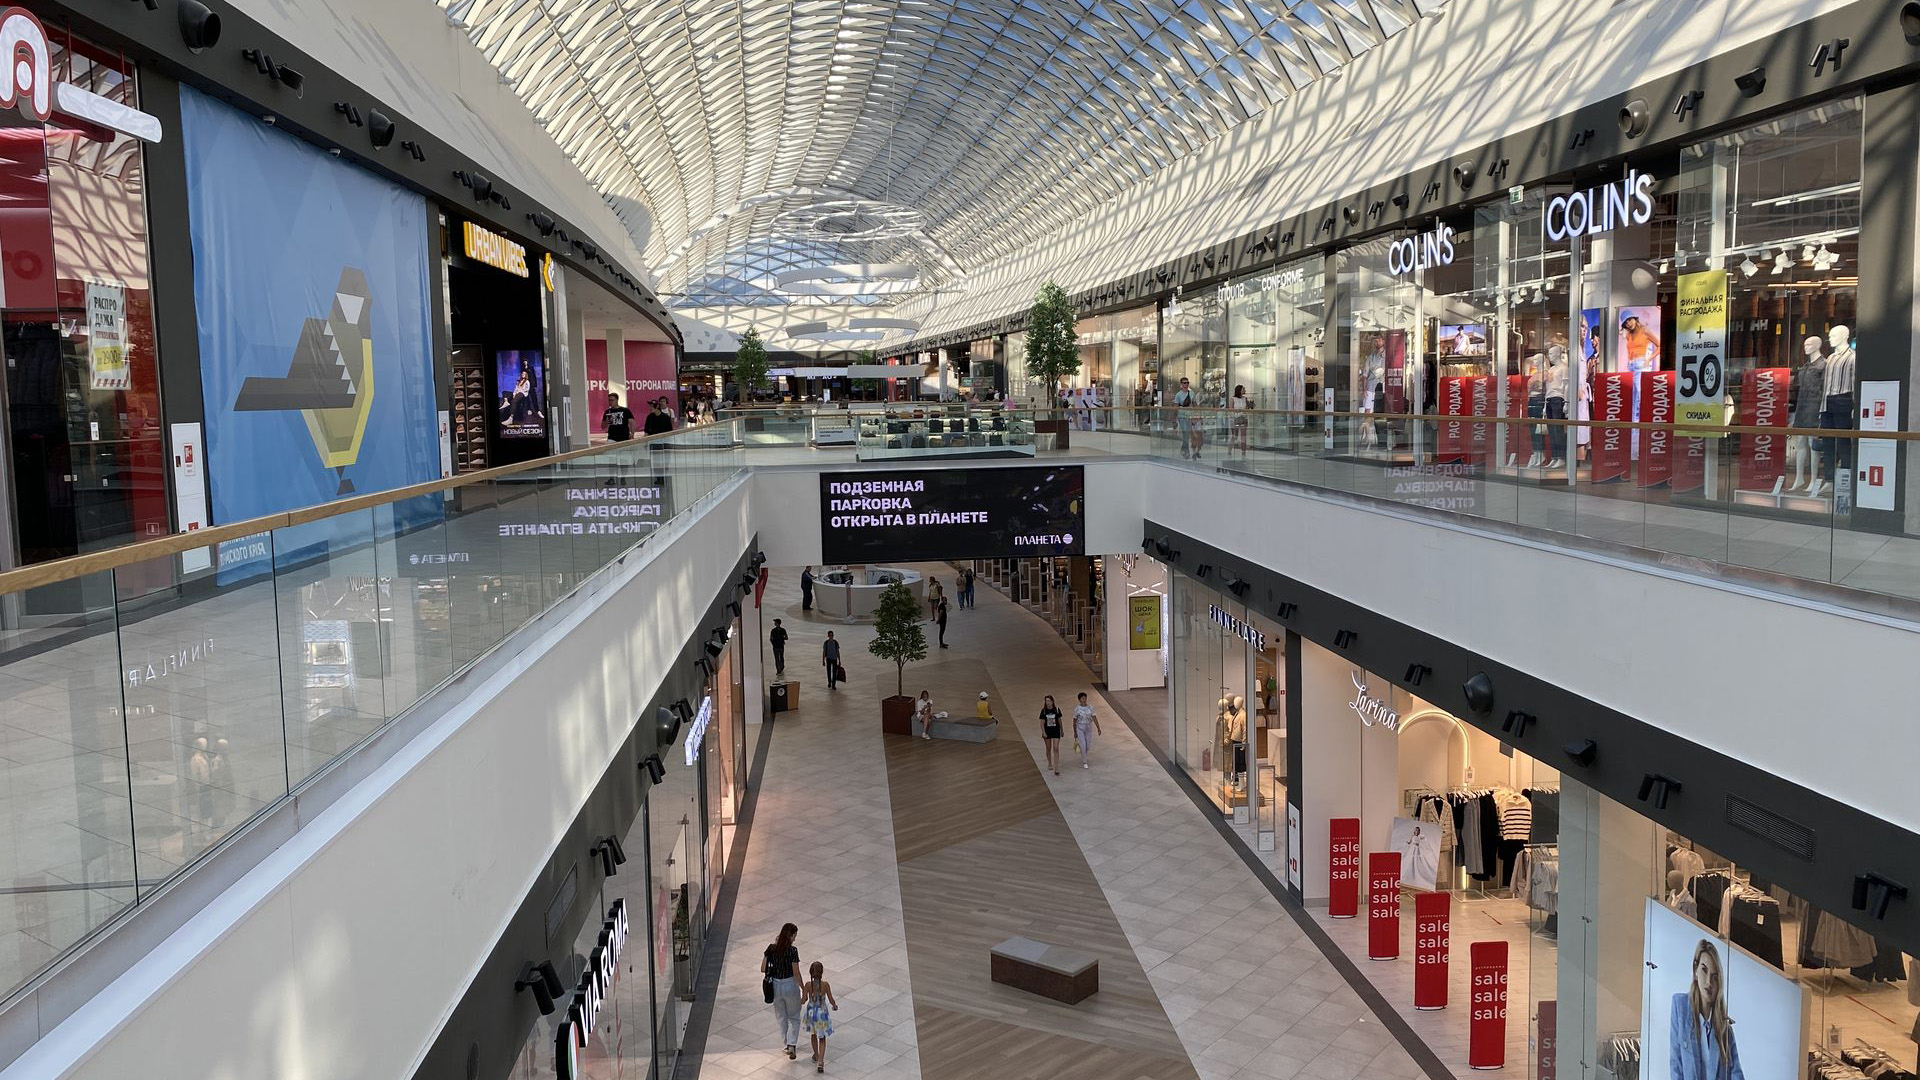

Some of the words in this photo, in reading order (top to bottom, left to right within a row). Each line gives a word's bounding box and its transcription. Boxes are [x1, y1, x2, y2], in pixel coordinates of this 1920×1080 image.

[1547, 169, 1656, 242] COLIN'S
[1388, 222, 1455, 276] COLIN'S
[1261, 267, 1304, 292] CONFORME
[1680, 294, 1723, 307] ФИНАЛЬНАЯ
[1680, 304, 1723, 316] РАСПРОДАЖА
[625, 379, 661, 391] СТОРОНА
[1449, 378, 1463, 439] РАСРОДАЖА
[1473, 377, 1488, 441] РАСРОДАЖА
[1605, 375, 1623, 451] РАСРОДАЖА
[1651, 373, 1669, 455] РАСРОДАЖА
[1755, 370, 1776, 461] РАСРОДАЖА
[1685, 411, 1712, 421] СКИДКА
[830, 480, 924, 496] ПОДЗЕМНАЯ
[831, 497, 911, 511] ПАРКОВКА
[831, 514, 903, 528] ОТКРЫТА
[906, 514, 916, 525] В
[919, 511, 988, 525] ПЛАНЕТЕ
[1015, 534, 1061, 546] ПЛАНЕТА
[1348, 670, 1399, 731] Larina
[1332, 842, 1360, 853] sale
[1332, 855, 1360, 866] sale
[1332, 868, 1359, 880] sale
[1373, 877, 1401, 889] sale
[1372, 891, 1401, 904] sale
[1372, 906, 1400, 918] sale
[1419, 920, 1450, 933] sale
[1419, 935, 1449, 948] sale
[1418, 951, 1449, 964] sale
[580, 970, 601, 1047] VIA
[600, 898, 630, 999] ROMA
[1475, 971, 1508, 986] sale
[1474, 988, 1507, 1003] sale
[1474, 1006, 1507, 1021] sale
